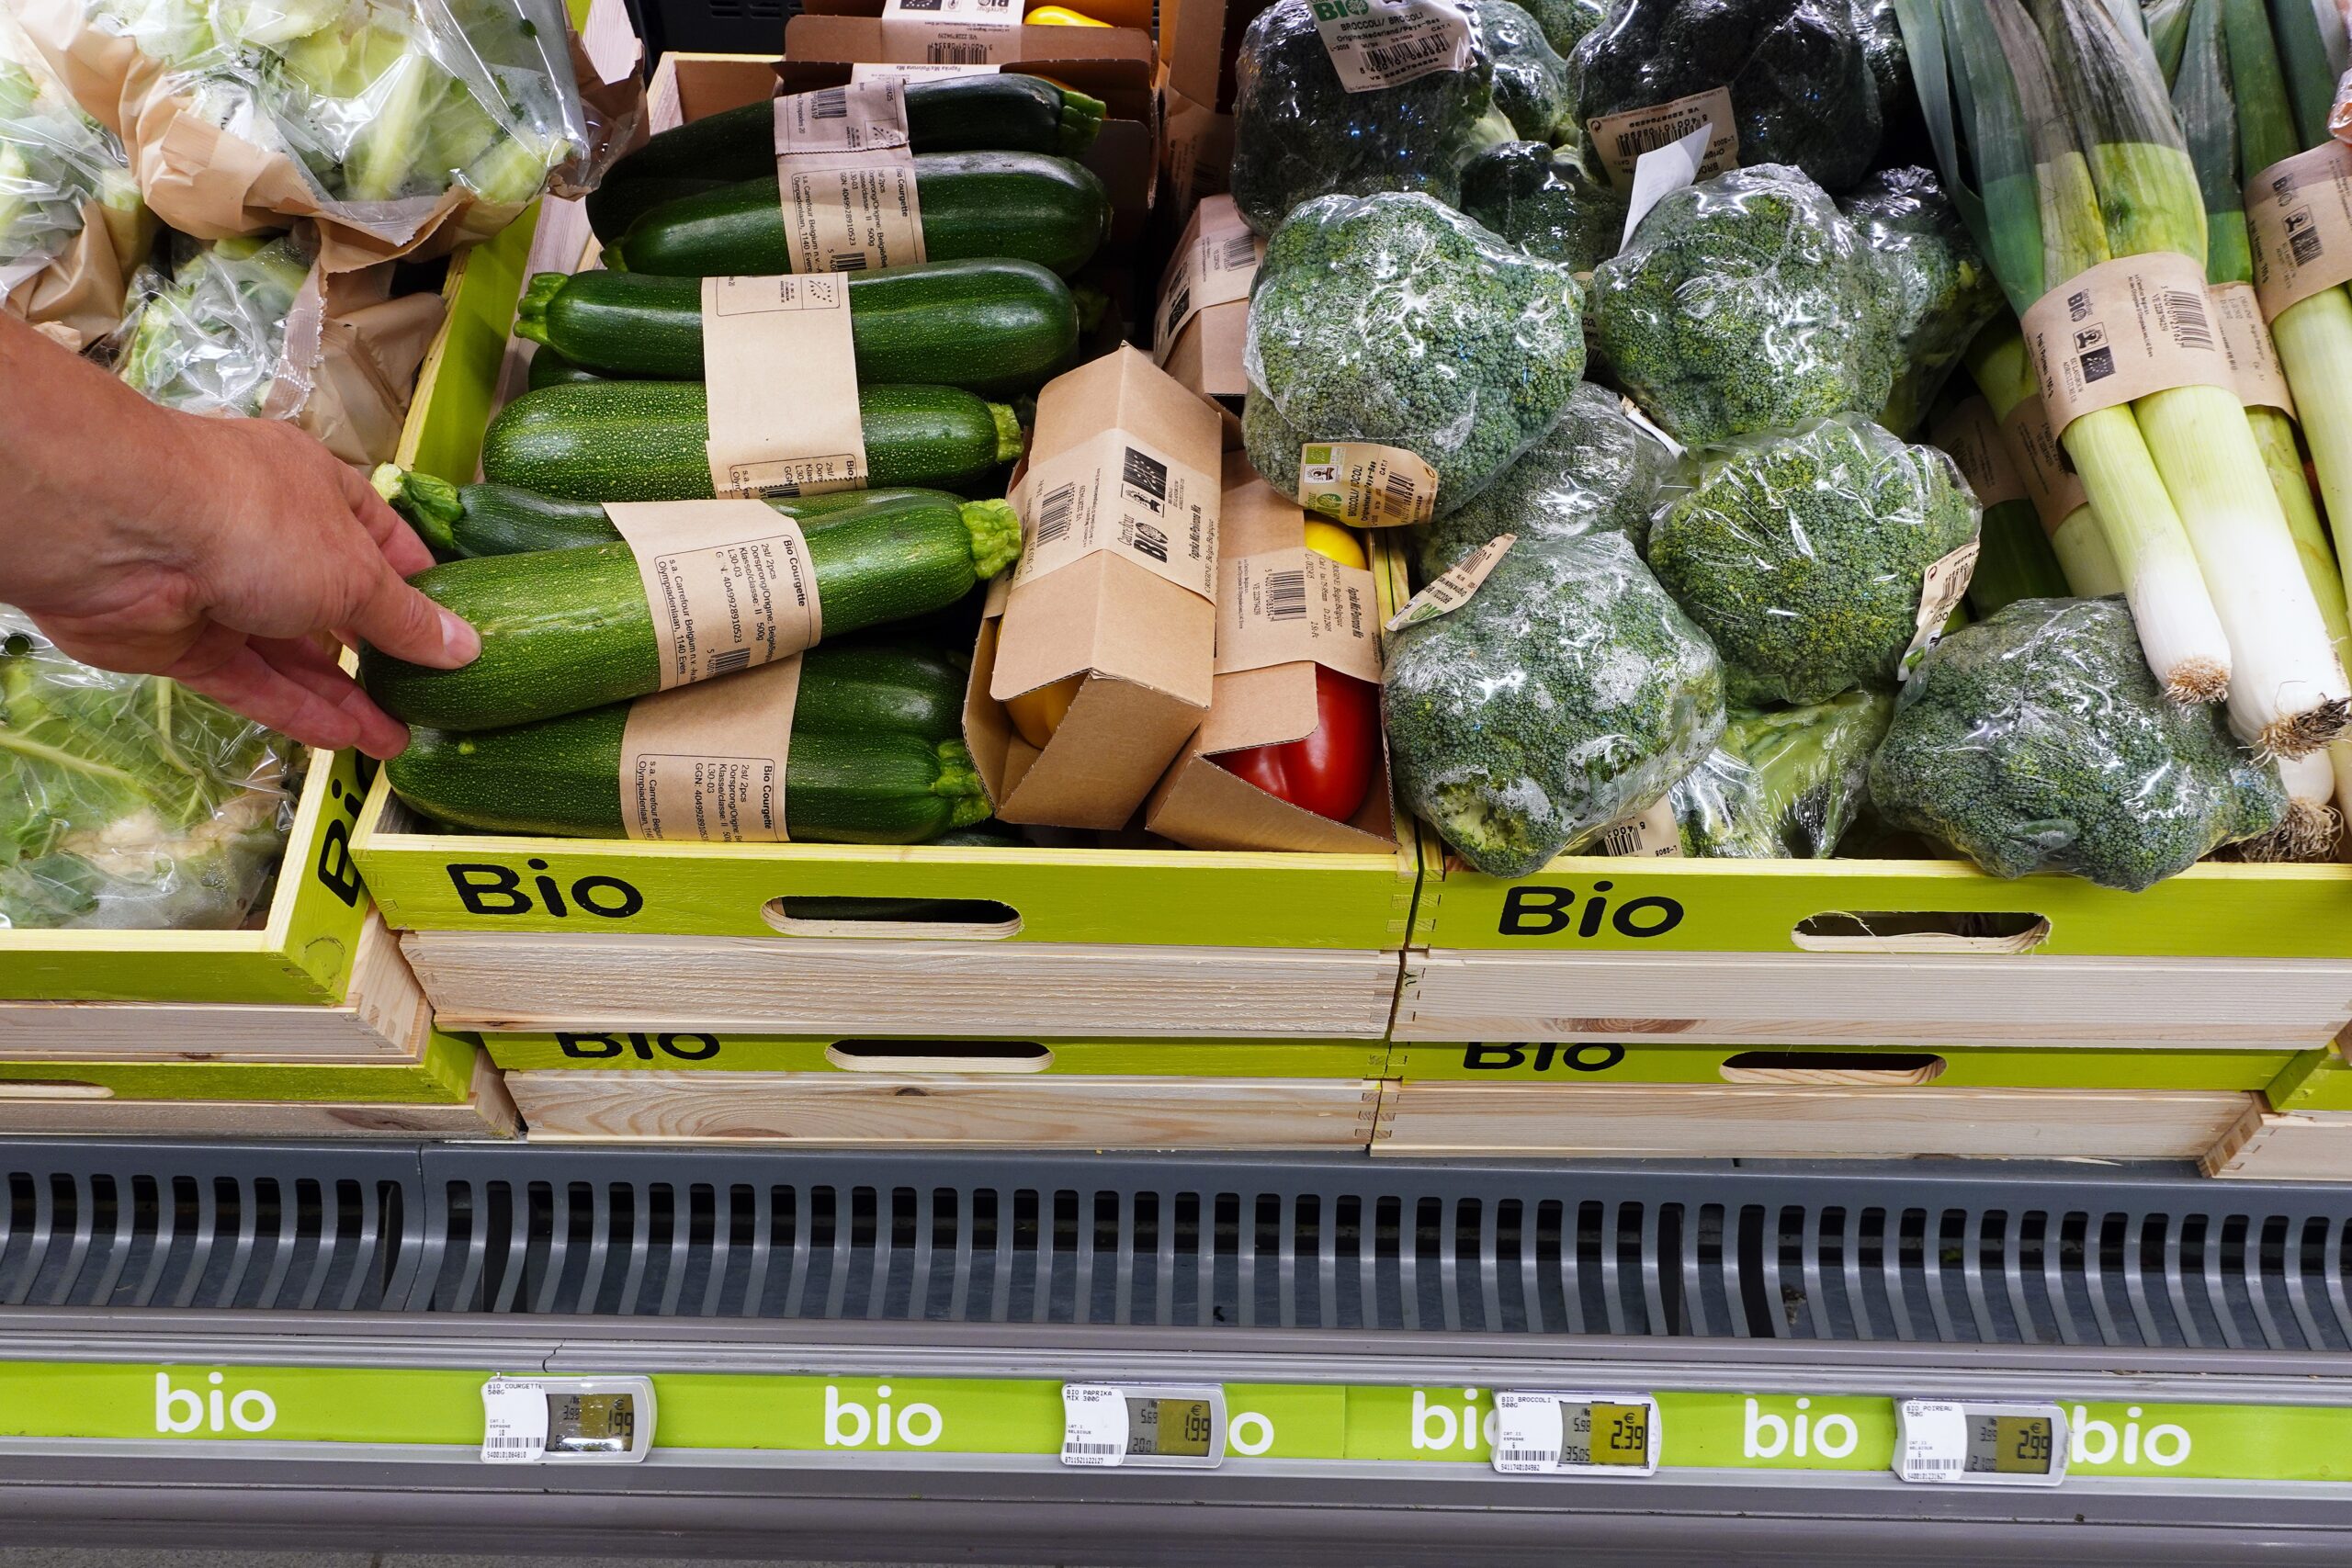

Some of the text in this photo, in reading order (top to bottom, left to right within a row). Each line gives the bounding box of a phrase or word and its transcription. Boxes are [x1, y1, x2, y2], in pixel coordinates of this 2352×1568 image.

[1312, 1, 1369, 22] BIO
[1697, 162, 1719, 174] BRO
[804, 186, 814, 217] Carrefour
[842, 187, 855, 246] 4049928910523
[897, 179, 909, 217] Courgette
[802, 232, 810, 250] 1140
[808, 219, 819, 250] Belgium
[866, 228, 876, 247] 500g
[2066, 292, 2086, 322] BIO
[846, 460, 854, 476] Bio
[1117, 513, 1135, 546] Carrefour
[1134, 523, 1168, 563] BIO
[728, 548, 742, 578] L30-03
[764, 559, 777, 580] 2pcs
[783, 540, 806, 606] Bio Courgette
[739, 547, 759, 606] Klasse/classe:
[755, 622, 765, 640] 500g
[751, 545, 775, 623] Oorsprong/Origine:
[658, 560, 688, 674] Olympiadenlaan, 1140 Evere
[669, 559, 697, 666] s.a. Carrefour Belgium n.v.
[722, 577, 742, 643] 4049928910523
[694, 762, 703, 787] GGN:
[707, 763, 716, 794] L30-03
[718, 763, 731, 821] Klasse/classe:
[740, 764, 750, 801] 2st/ 2pcs
[636, 761, 649, 826] Olympiadenlaan,
[649, 780, 658, 817] Carrefour
[728, 764, 741, 834] Oorsprong/Origine:
[762, 765, 773, 829] Bio Courgette
[1640, 821, 1645, 829] 5
[447, 859, 643, 917] Bio
[1498, 881, 1684, 937] Bio
[156, 1372, 277, 1433] bio
[824, 1385, 942, 1447] bio
[1185, 1413, 1211, 1442] 1.99
[1611, 1420, 1644, 1450] 2.39
[1744, 1398, 1858, 1459] bio
[2016, 1430, 2050, 1460] 2.99
[2071, 1406, 2190, 1467] bio
